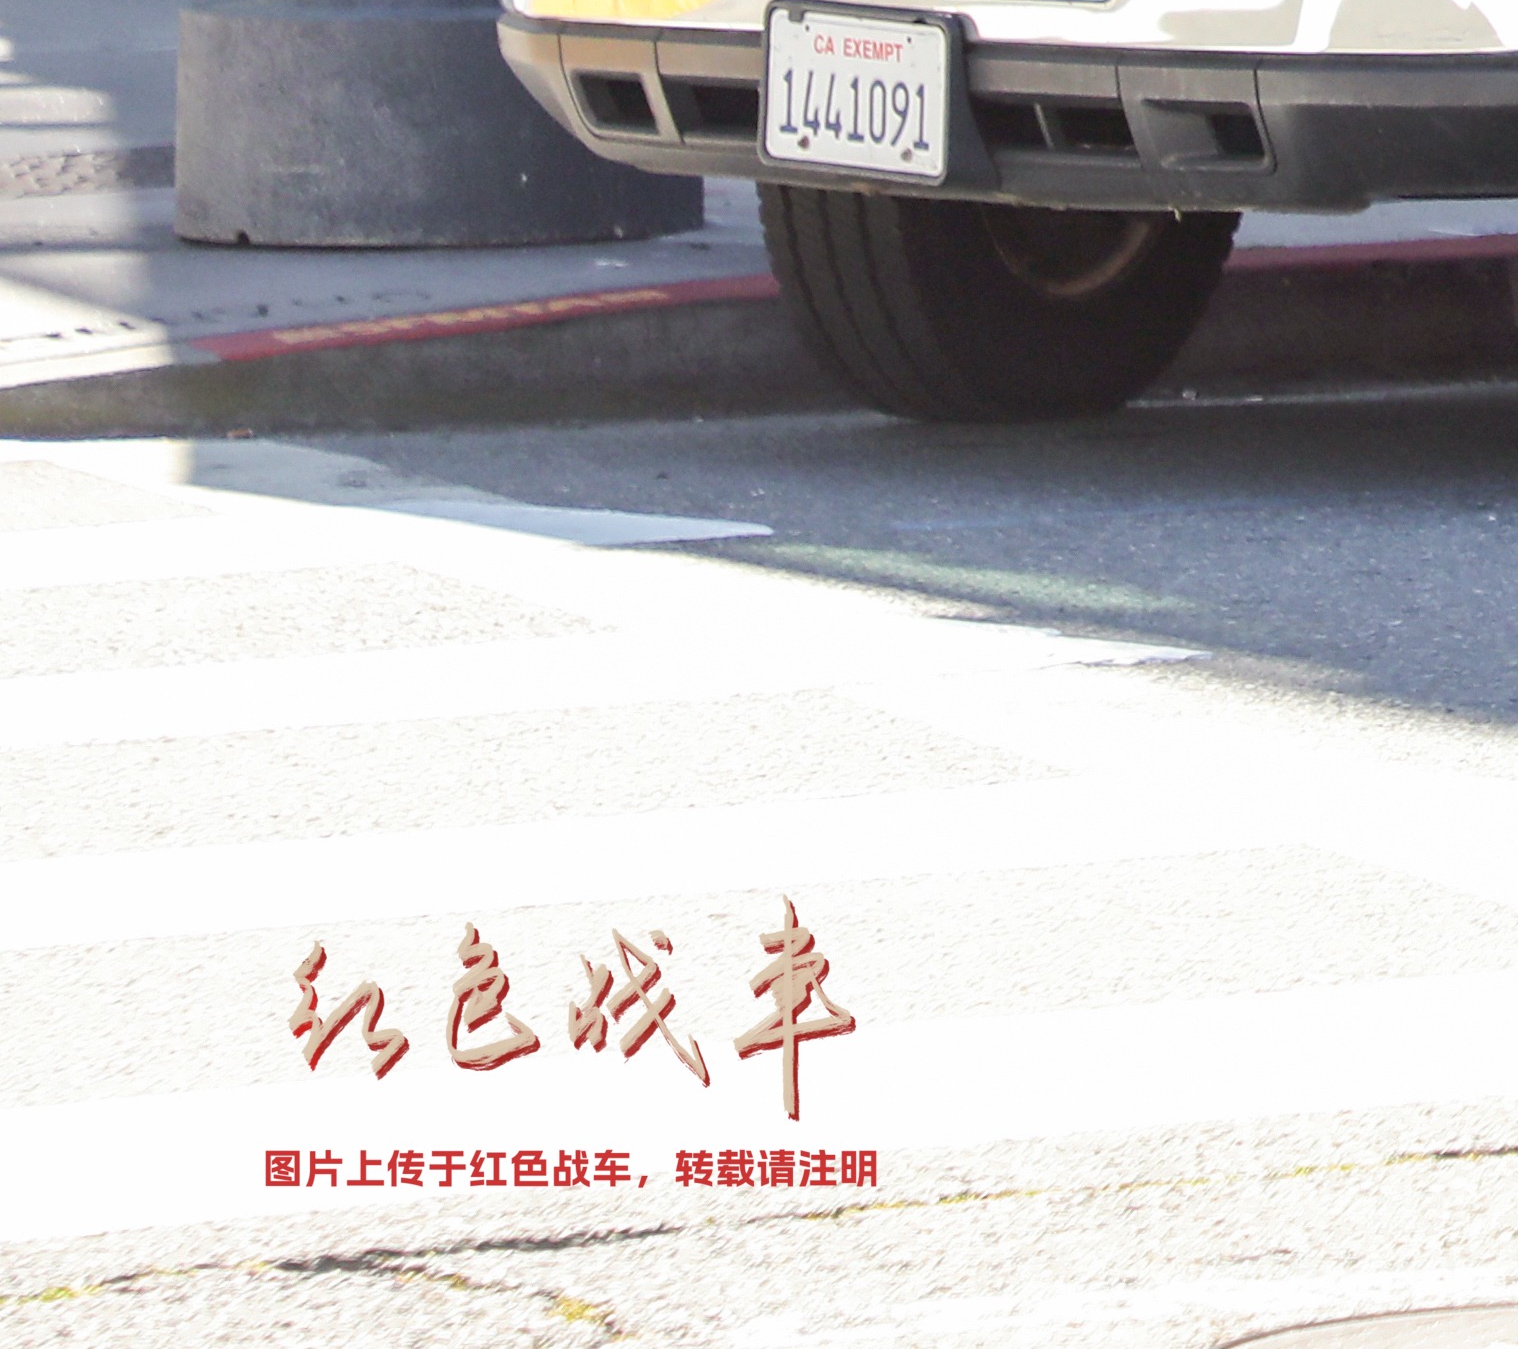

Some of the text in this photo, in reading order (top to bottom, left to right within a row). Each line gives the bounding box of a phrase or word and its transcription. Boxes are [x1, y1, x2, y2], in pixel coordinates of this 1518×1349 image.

[813, 34, 904, 63] CA EXEMPT
[779, 67, 930, 151] 1441091
